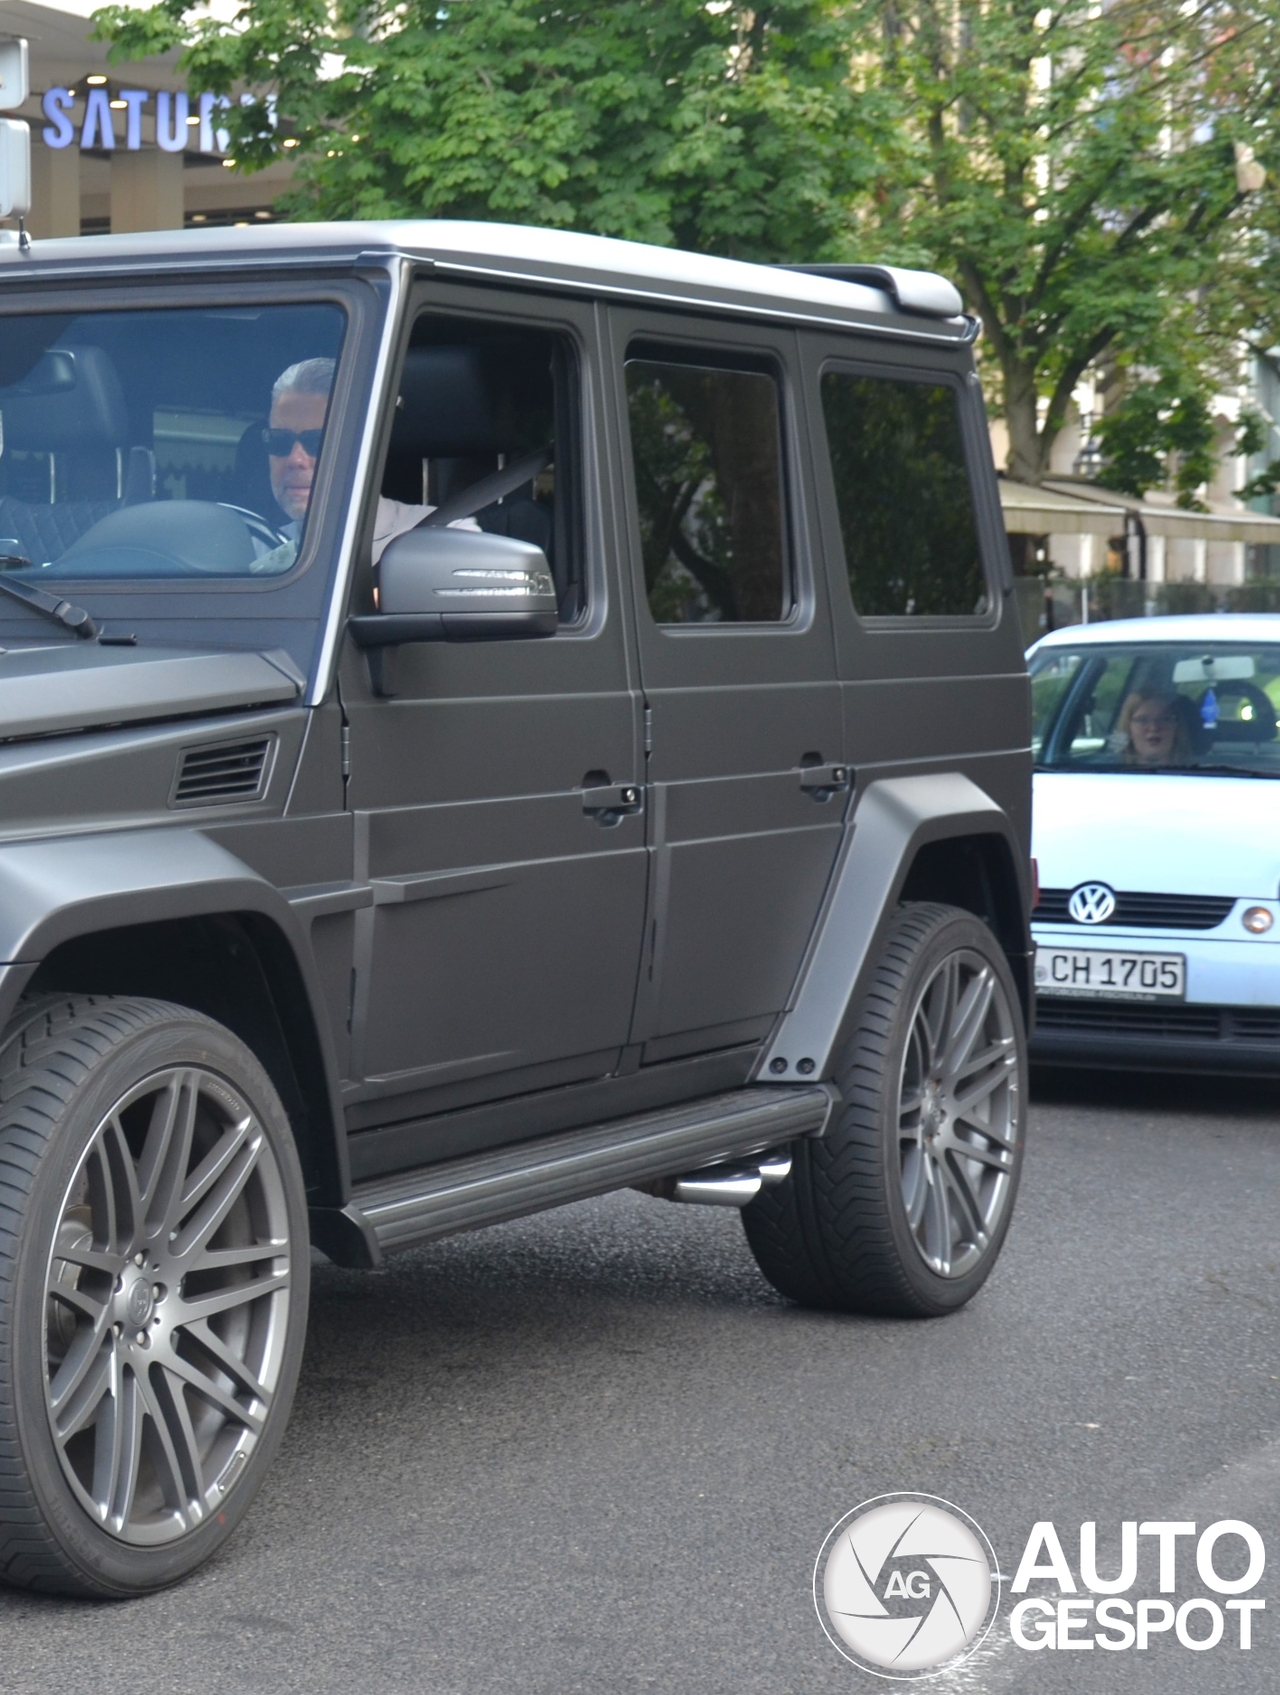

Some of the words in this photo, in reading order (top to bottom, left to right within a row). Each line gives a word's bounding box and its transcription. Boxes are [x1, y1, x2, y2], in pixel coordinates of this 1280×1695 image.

[1072, 887, 1112, 920] VW
[1051, 955, 1091, 984] CH
[1100, 958, 1178, 989] 1705
